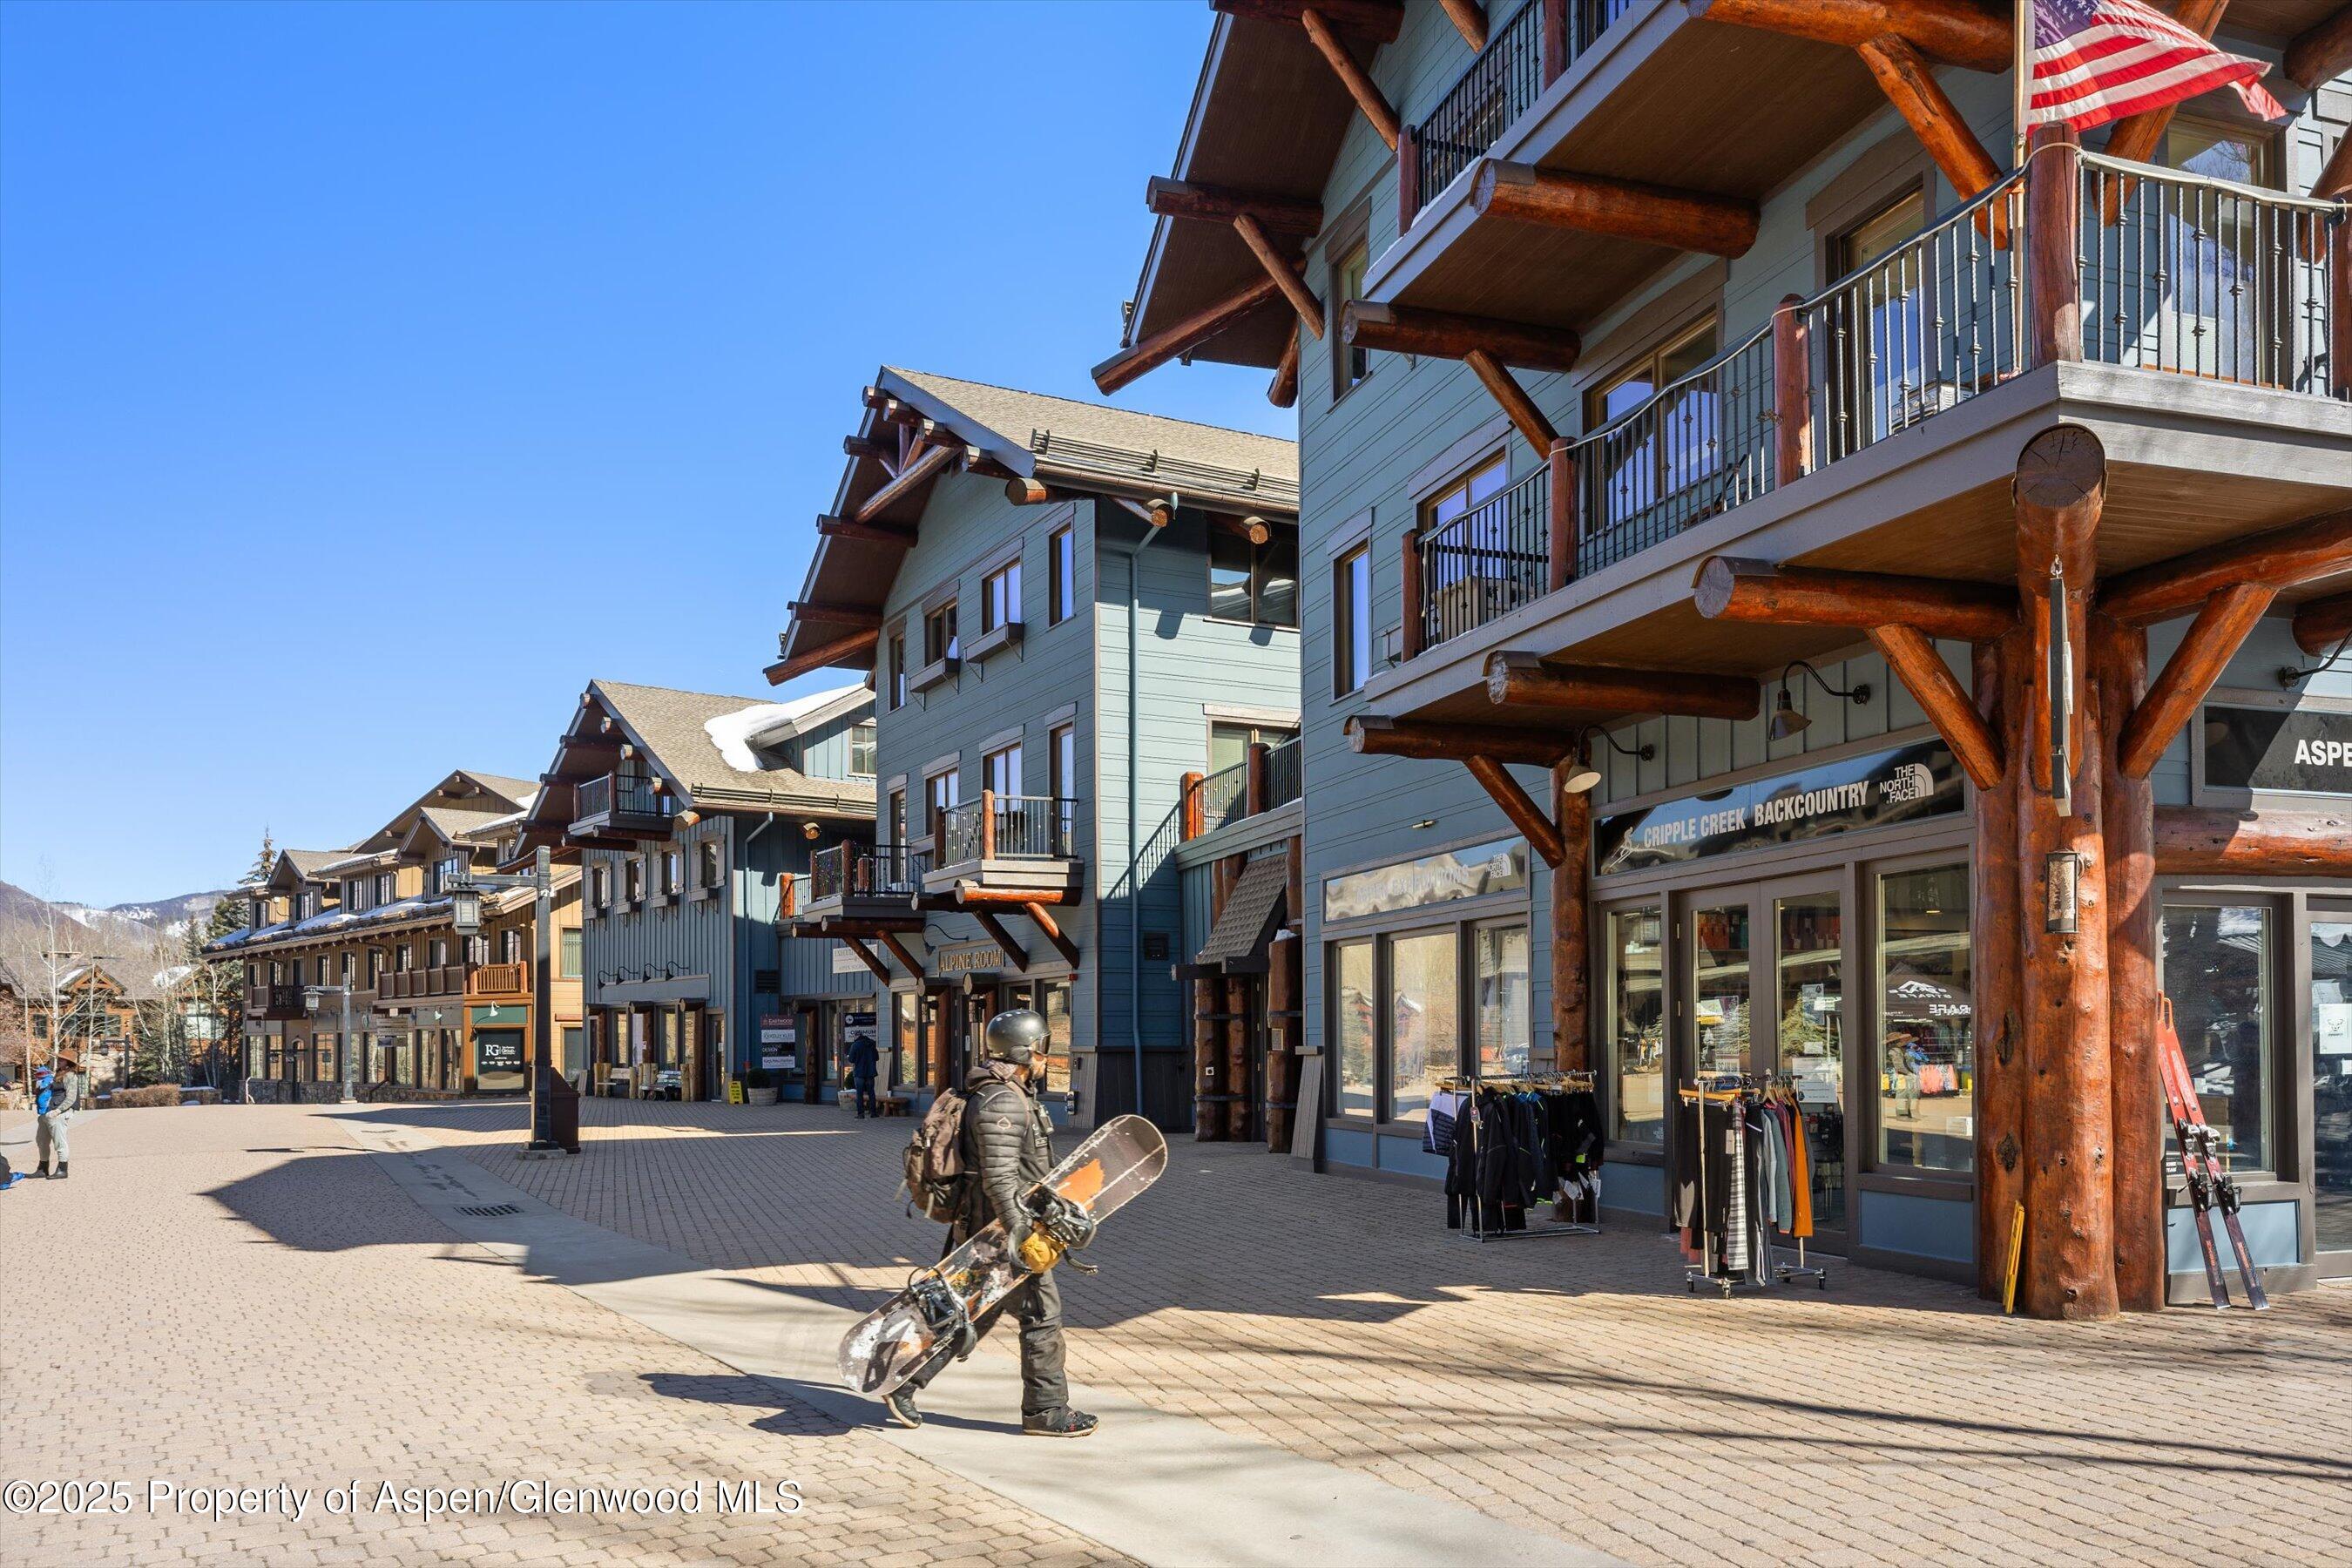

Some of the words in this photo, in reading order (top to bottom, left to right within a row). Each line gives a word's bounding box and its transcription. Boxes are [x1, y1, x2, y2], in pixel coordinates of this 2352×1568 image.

[1895, 763, 1915, 779] THE
[1879, 778, 1915, 794] NORTH
[1889, 787, 1916, 804] FACE
[1644, 817, 1696, 848] CRIPPLE
[1700, 808, 1747, 837] CREEK
[1754, 781, 1869, 827] BACKCOUNTRY
[1492, 854, 1504, 862] THE
[1485, 861, 1504, 872] NORTH
[1490, 869, 1504, 879] FACE
[940, 953, 972, 971] ALPINE
[975, 948, 1004, 969] ROOM
